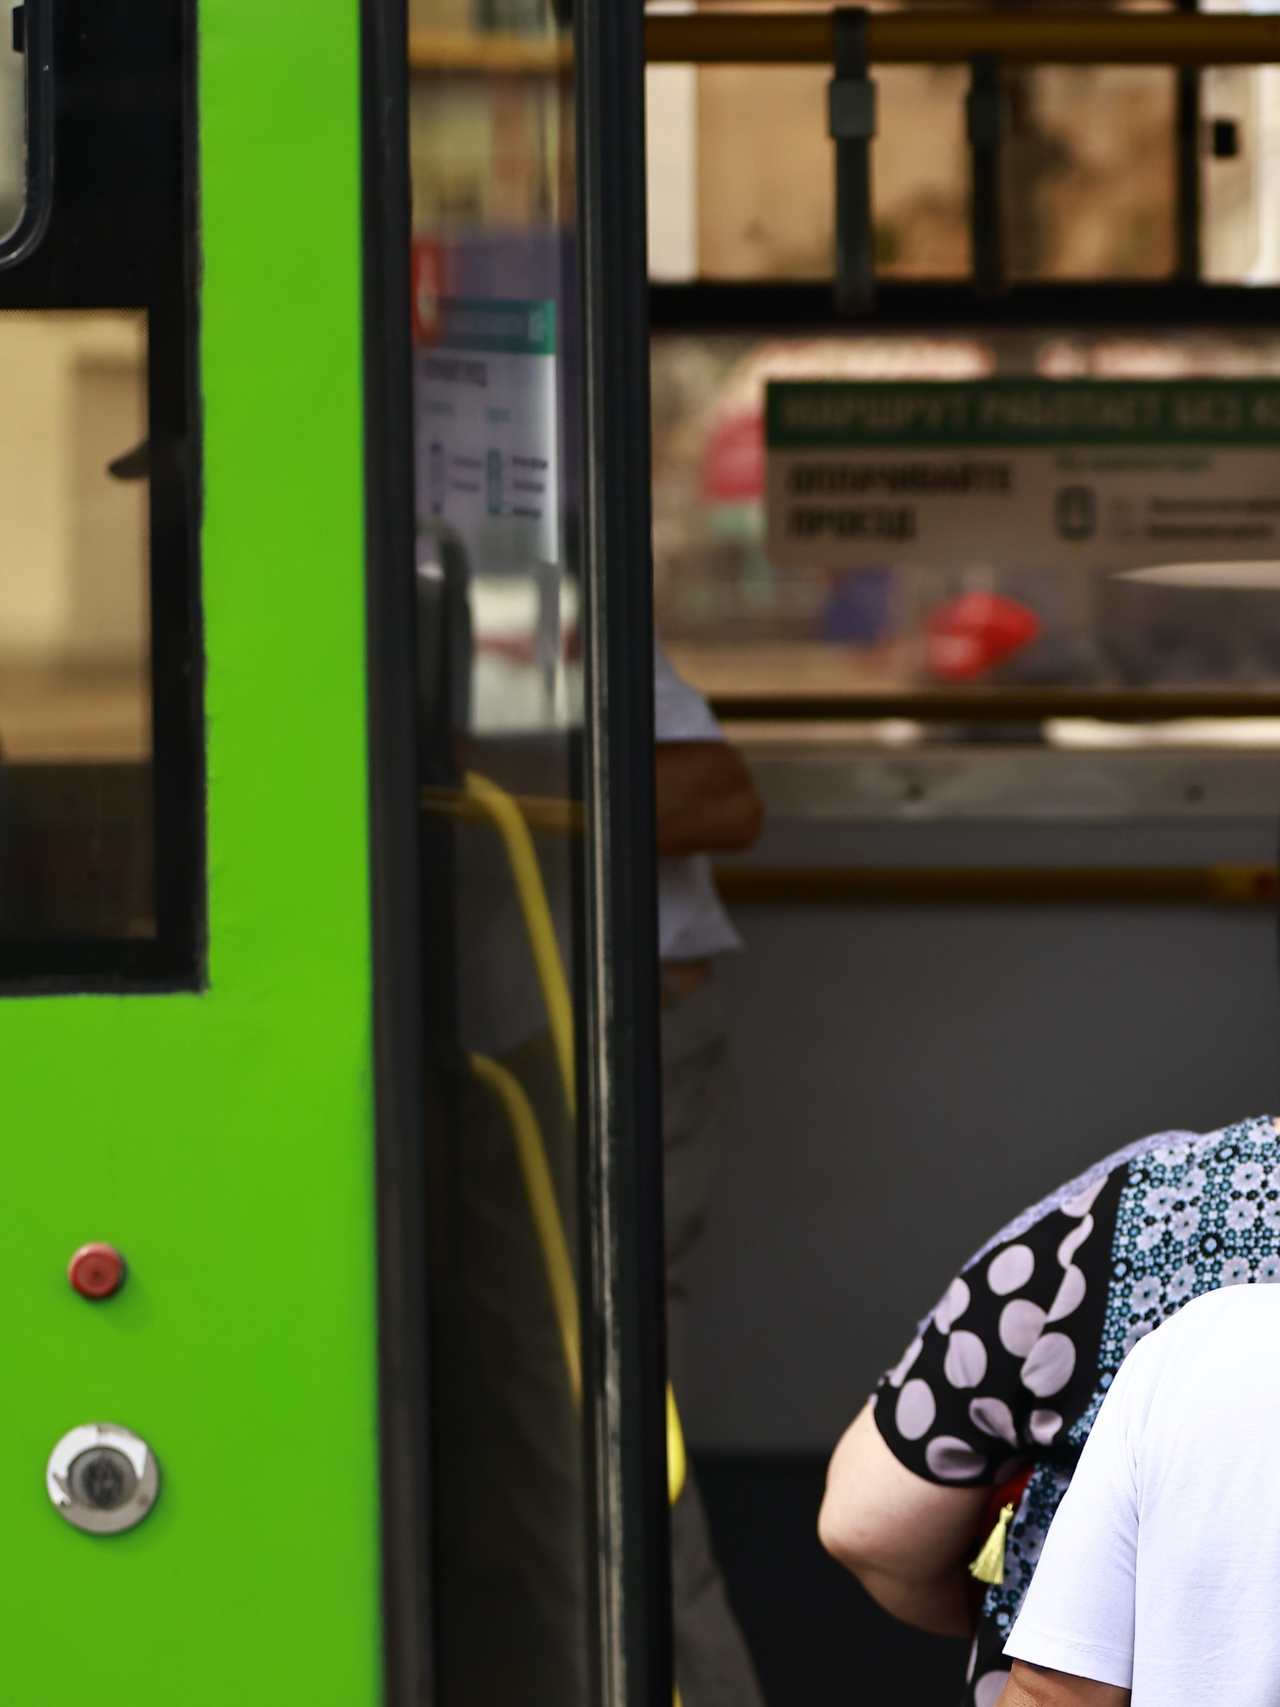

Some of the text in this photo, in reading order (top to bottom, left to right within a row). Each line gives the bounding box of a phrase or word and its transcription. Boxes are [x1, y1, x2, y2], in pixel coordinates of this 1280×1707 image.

[782, 393, 967, 430] МАРШРУТ
[979, 393, 1162, 429] РАБОТАЕТ
[1174, 393, 1242, 429] БЕЗ
[788, 506, 918, 541] ПРОЕЗД
